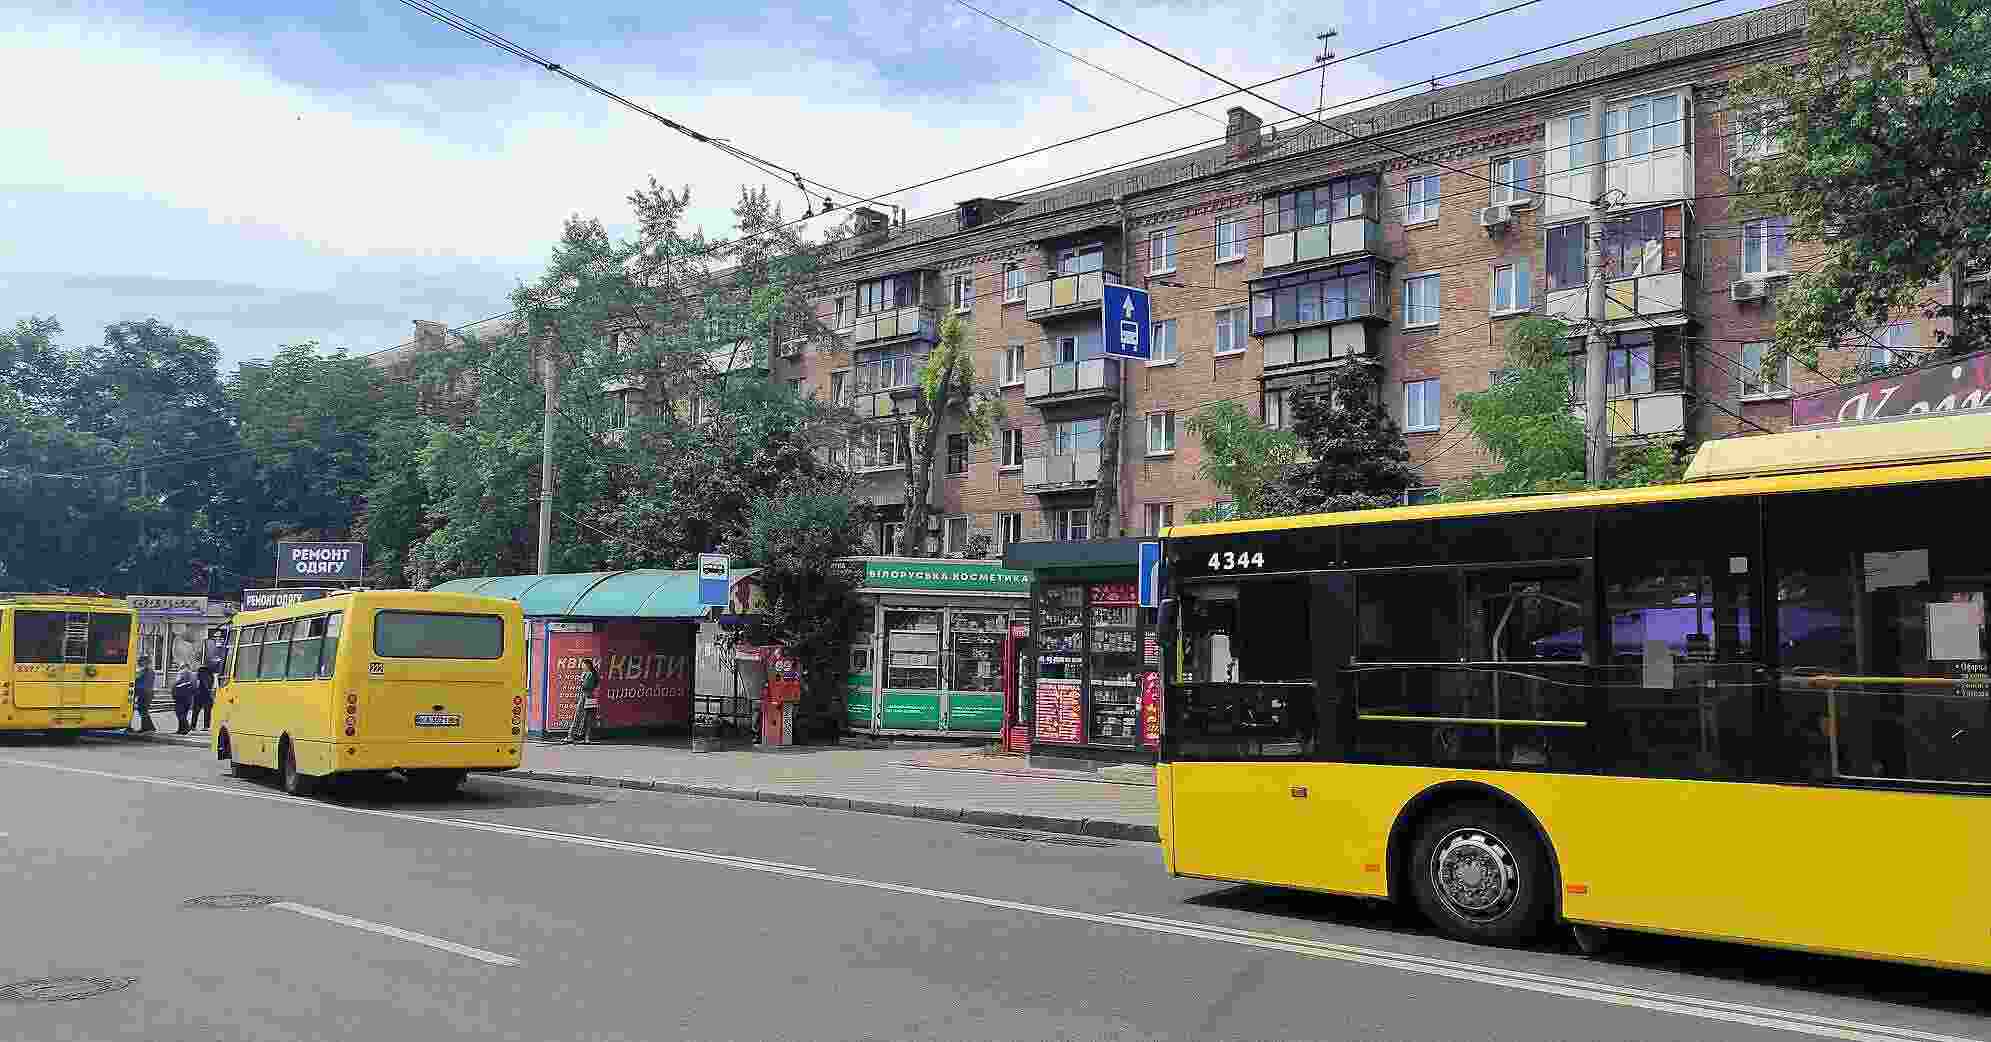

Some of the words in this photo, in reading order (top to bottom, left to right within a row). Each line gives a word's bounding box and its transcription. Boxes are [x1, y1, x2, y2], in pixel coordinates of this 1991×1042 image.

[292, 548, 350, 561] РЕМОНТ
[1207, 551, 1265, 570] 4344
[295, 561, 345, 575] ОДЯГУ
[869, 569, 948, 580] БІЛОРУСЬКА
[952, 572, 1030, 584] КОСМЕТИКА
[246, 592, 277, 608] РЕМОНТ
[607, 655, 685, 680] КВІТИ
